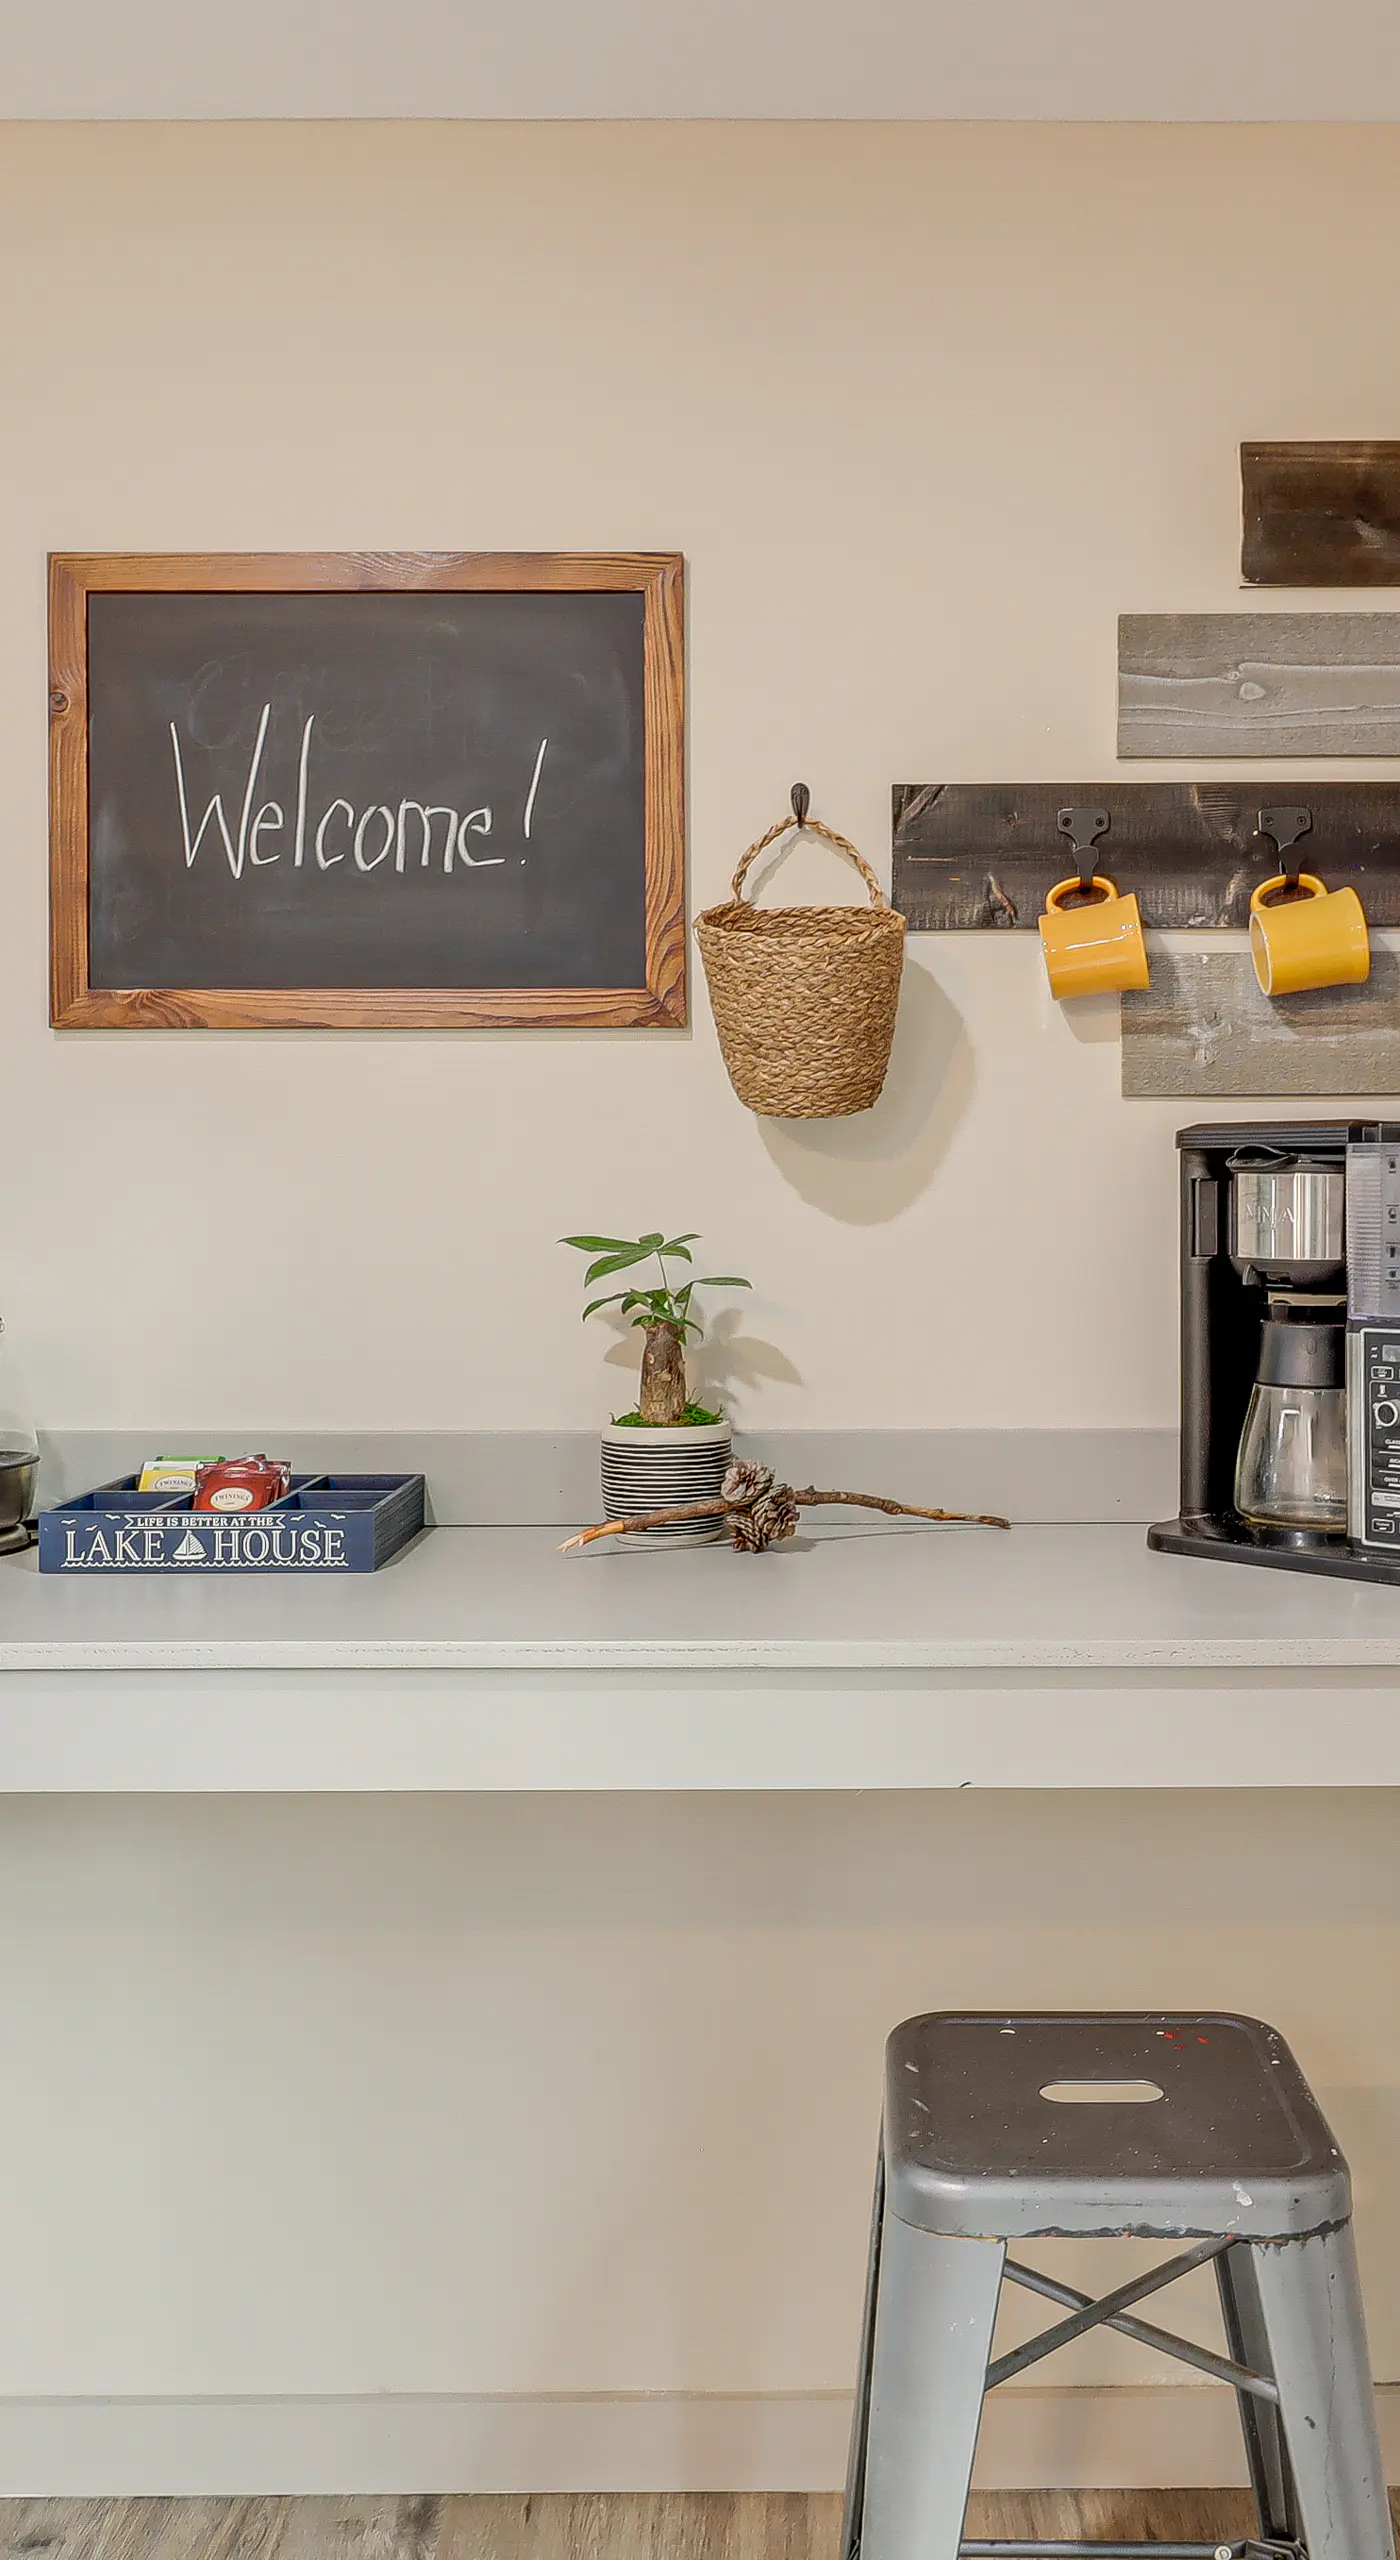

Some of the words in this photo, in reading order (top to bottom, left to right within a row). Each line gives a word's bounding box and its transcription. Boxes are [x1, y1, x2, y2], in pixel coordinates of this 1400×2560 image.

[169, 702, 548, 880] Welcome!
[137, 1518, 164, 1527] LIFE
[166, 1518, 179, 1527] IS
[181, 1517, 229, 1527] BETTER
[229, 1517, 247, 1527] AT
[247, 1517, 274, 1527] THE
[65, 1530, 166, 1562] LAKE
[213, 1530, 346, 1562] HOUSE
